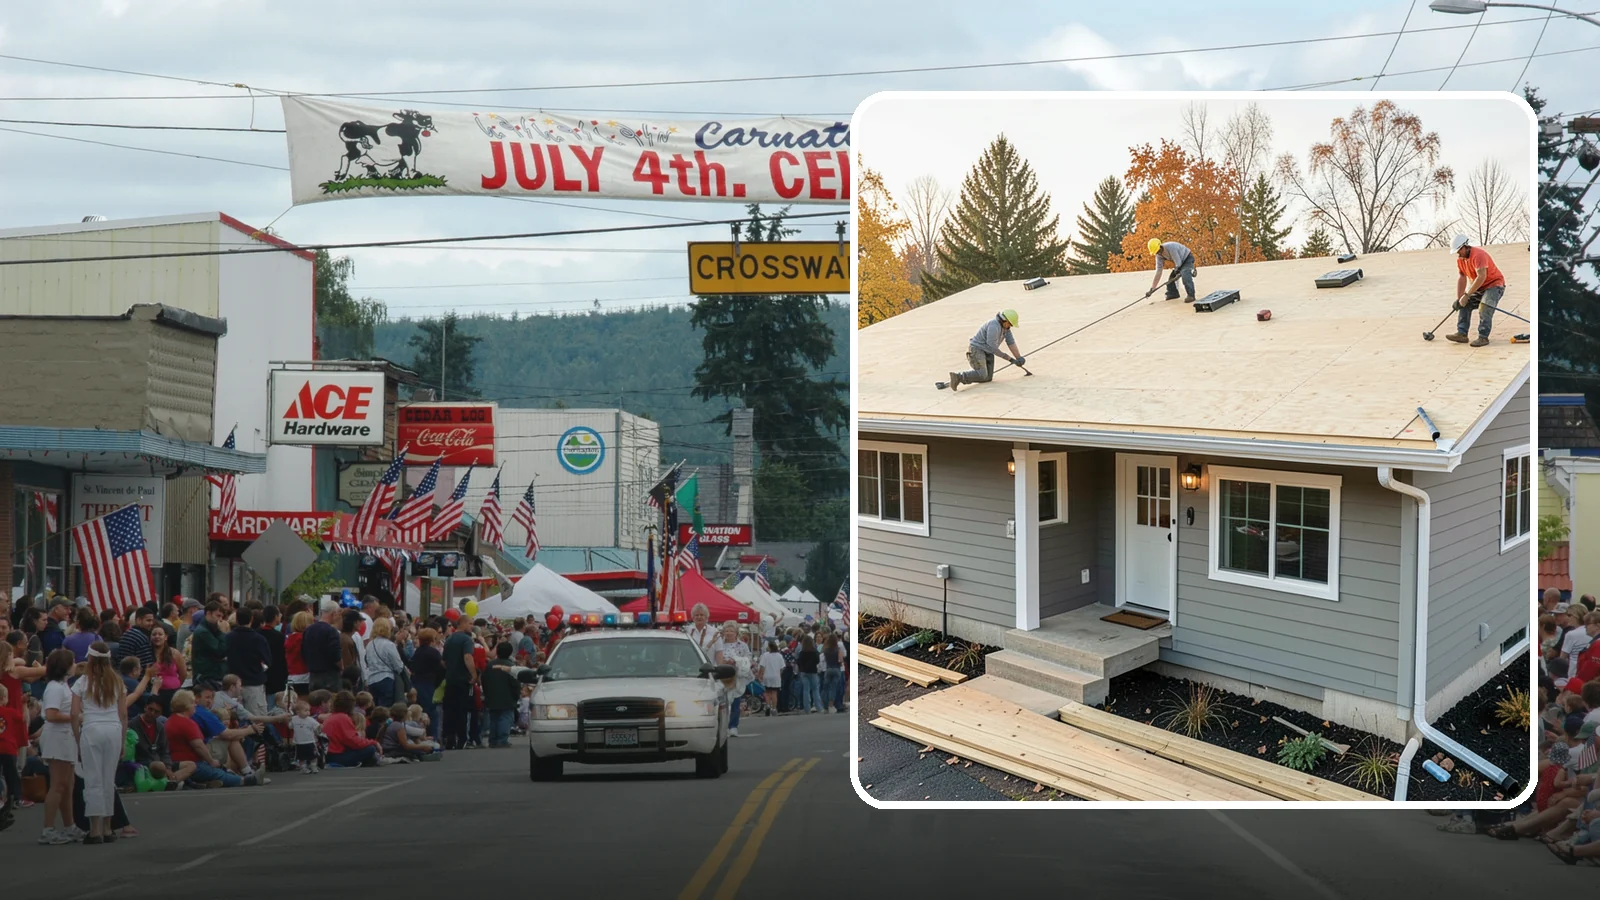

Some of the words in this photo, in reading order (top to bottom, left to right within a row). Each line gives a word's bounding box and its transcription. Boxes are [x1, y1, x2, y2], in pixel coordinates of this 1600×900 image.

[481, 141, 605, 192] JULY
[632, 148, 746, 198] 4th.
[697, 254, 850, 280] CROSSWA
[282, 380, 374, 420] ACE
[405, 409, 452, 421] CEDAR
[461, 409, 485, 421] LOG
[283, 421, 371, 438] Hardware
[416, 428, 477, 447] Coca-Cola
[353, 467, 385, 480] Simpl
[83, 485, 92, 494] St.
[96, 485, 124, 495] Vincent
[126, 486, 135, 495] de
[138, 486, 155, 495] Paul
[688, 526, 741, 535] CRNATION
[699, 535, 730, 543] GLASS
